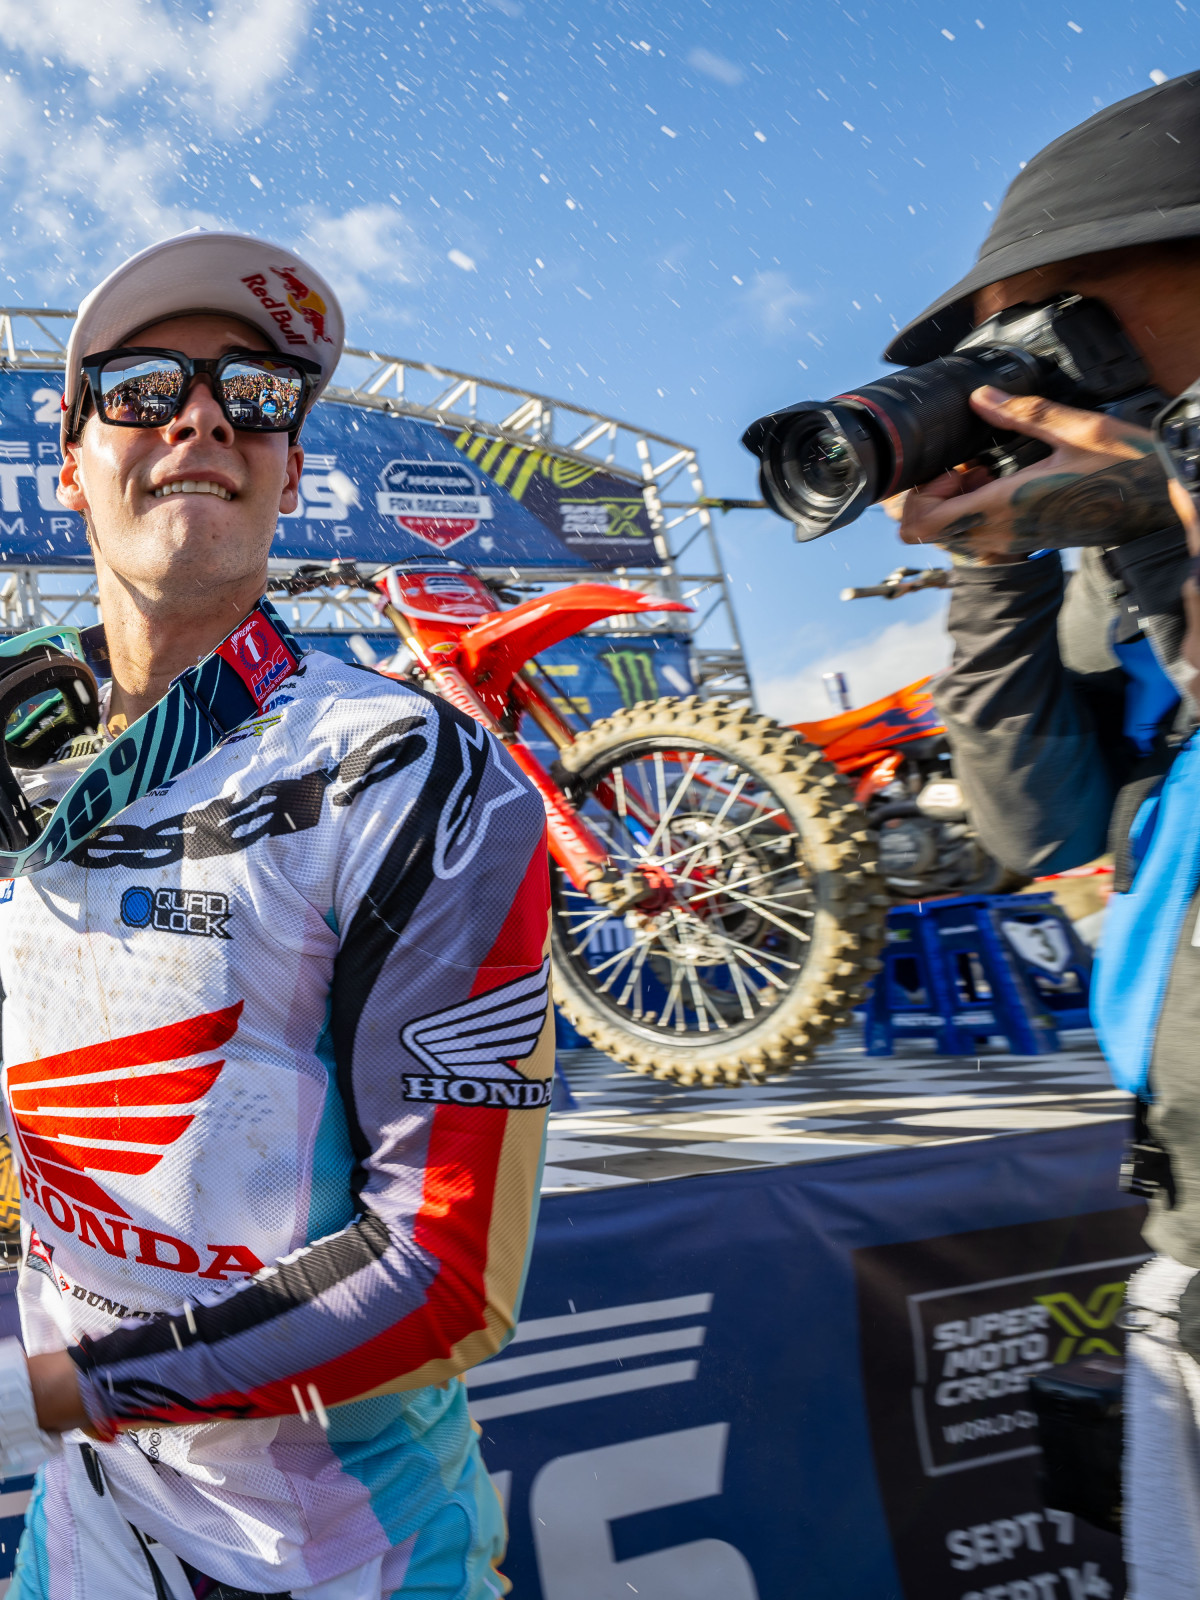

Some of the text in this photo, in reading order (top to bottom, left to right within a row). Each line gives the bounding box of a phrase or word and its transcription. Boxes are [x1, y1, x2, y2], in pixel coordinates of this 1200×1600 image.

[241, 273, 308, 345] Red Bull
[407, 477, 472, 488] HONDA
[244, 632, 262, 663] 1
[251, 645, 289, 697] HRC
[154, 909, 225, 936] LOCK
[155, 890, 227, 914] QUAD
[19, 1165, 266, 1281] HONDA
[933, 1305, 1050, 1349] SUPER
[942, 1334, 1049, 1377] MOTO
[935, 1361, 1054, 1406] CROS
[943, 1413, 1016, 1443] WORLD
[946, 1508, 1074, 1570] SEPT 7
